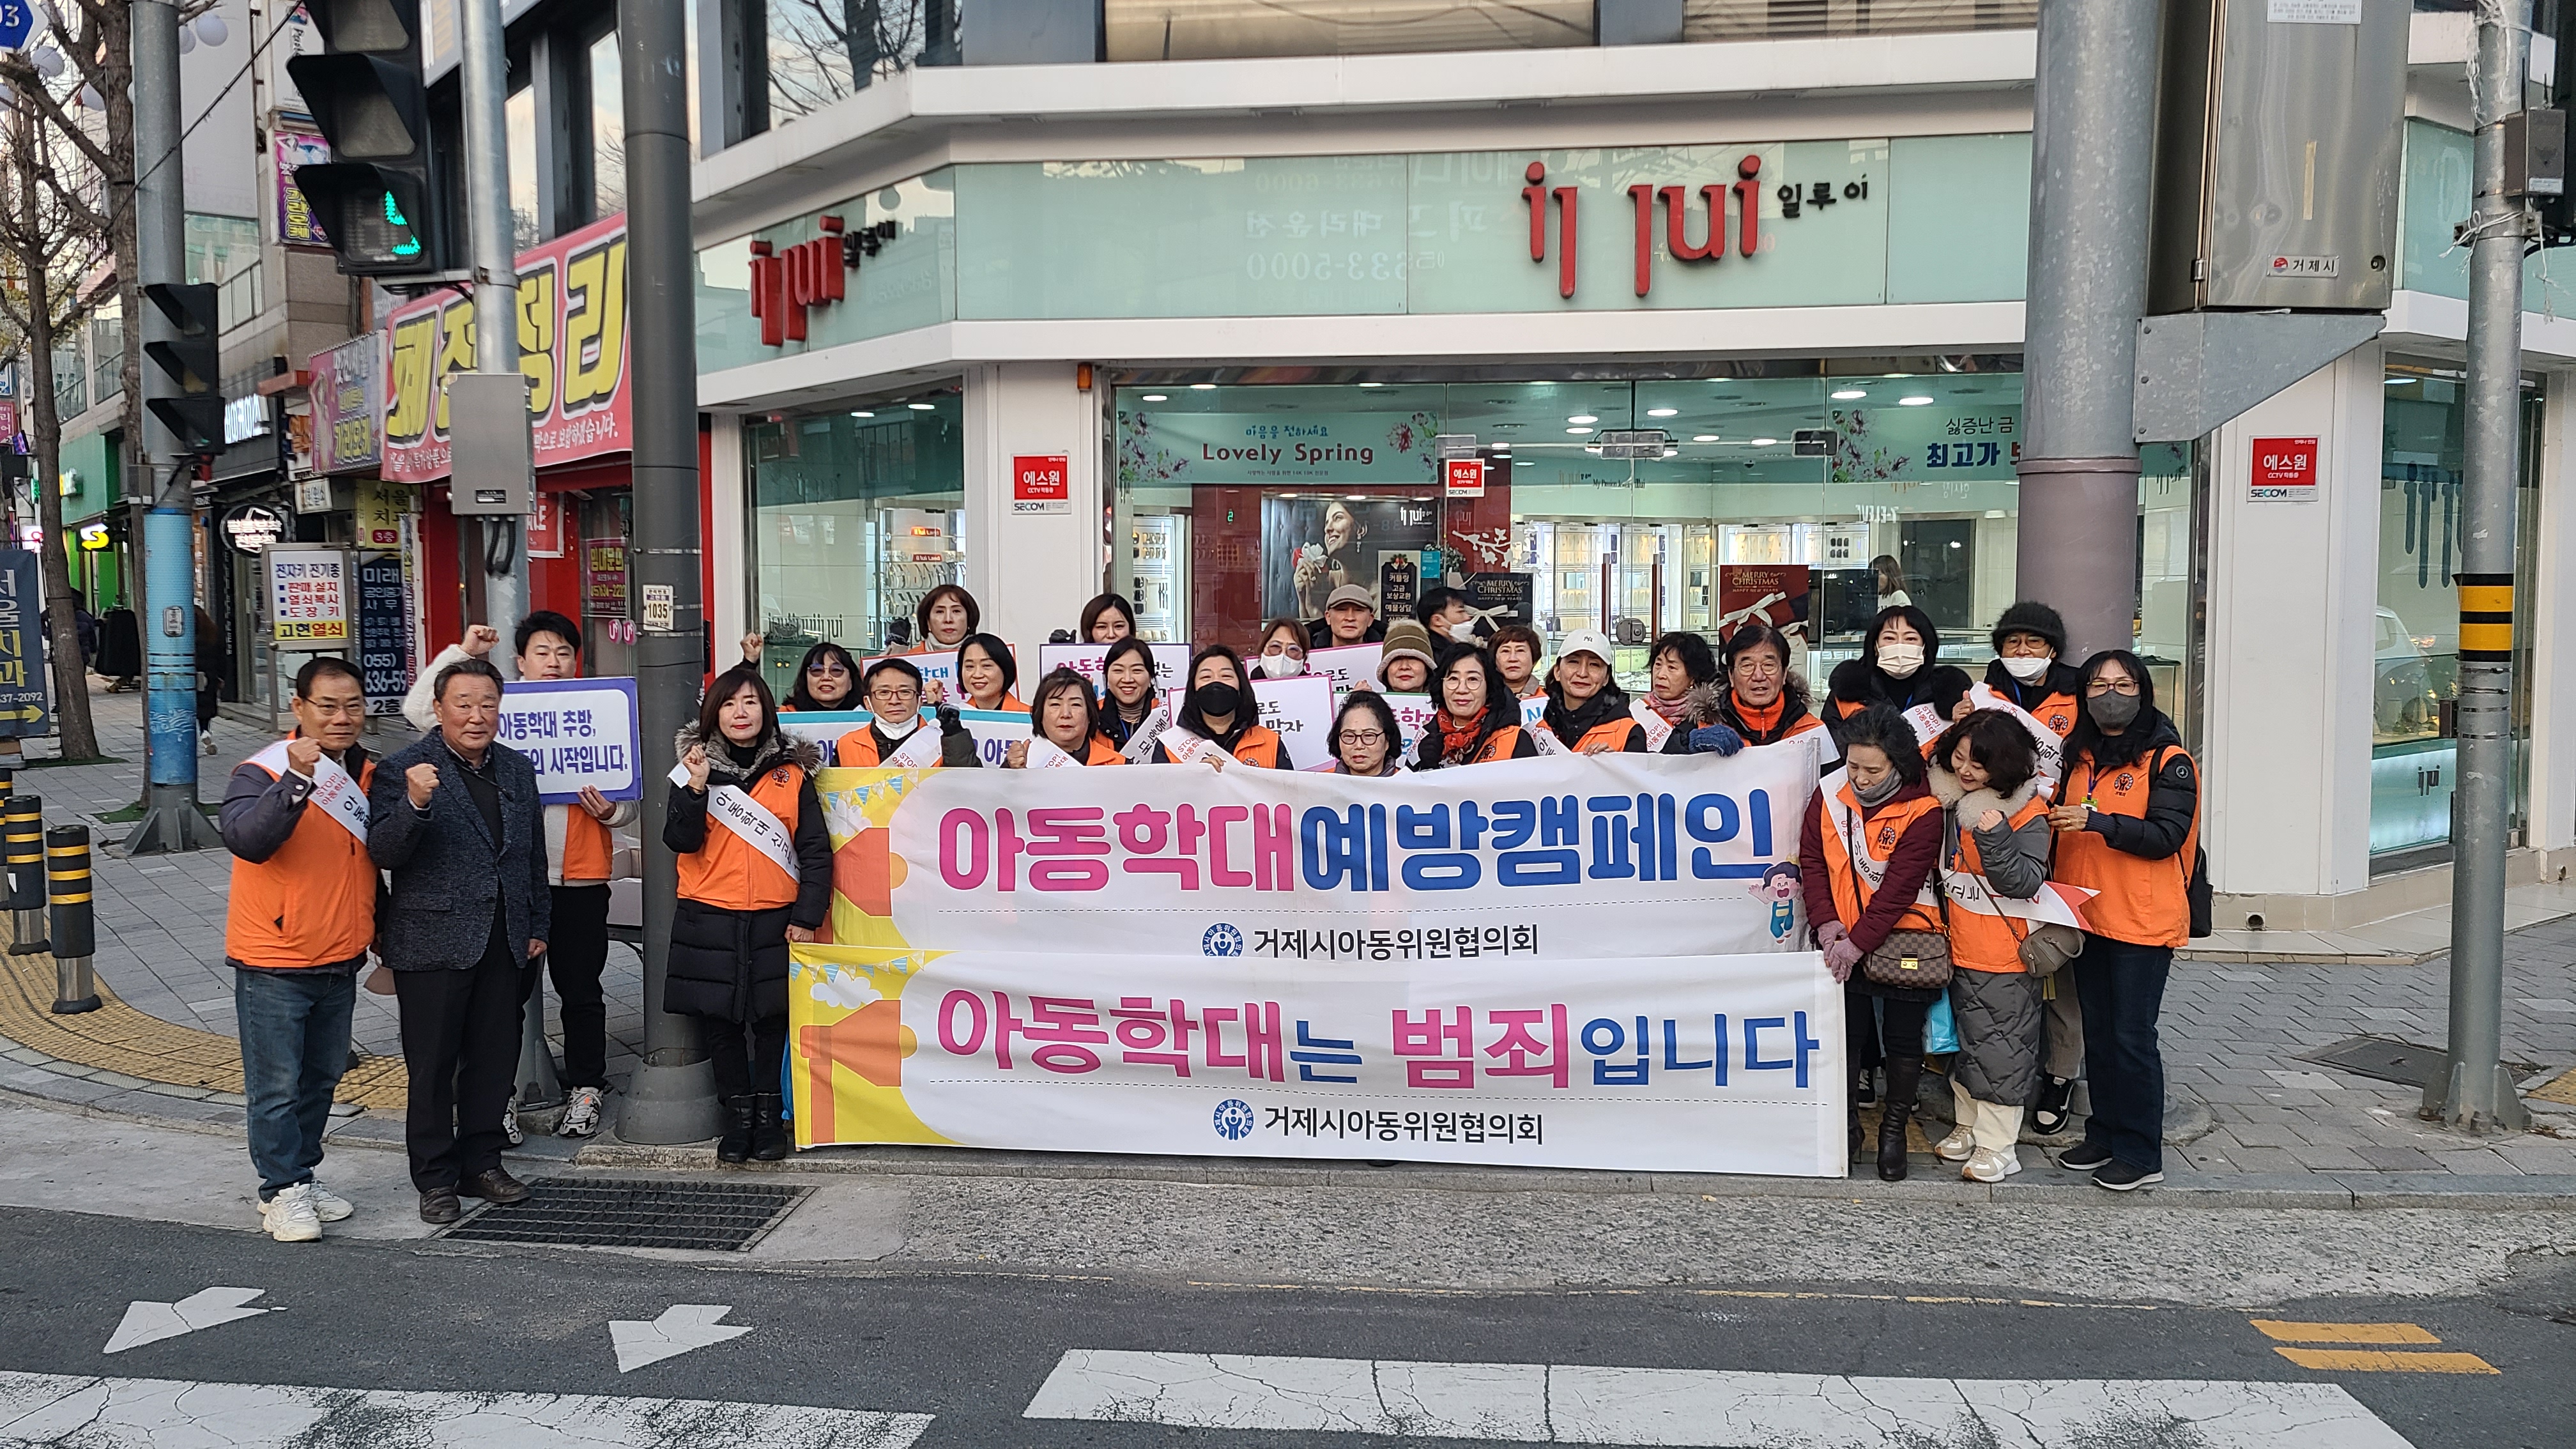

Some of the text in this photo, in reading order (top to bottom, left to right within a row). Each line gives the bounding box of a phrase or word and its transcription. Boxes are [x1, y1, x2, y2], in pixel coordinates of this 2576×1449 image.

[1777, 174, 1869, 218] 일루이
[2292, 259, 2335, 273] 거제시
[1284, 424, 1329, 438] 전하세요
[1946, 417, 2014, 435] 싫증난 금
[1202, 443, 1374, 465] Lovely Spring
[1926, 442, 2001, 468] 최고가
[2263, 454, 2308, 471] 에스원
[1022, 470, 1061, 486] 에스원
[1453, 468, 1478, 479] 에스원
[2250, 489, 2287, 498] SECOM
[1014, 502, 1045, 511] SECOM
[374, 530, 396, 542] 3층
[590, 546, 624, 572] 임대문의
[363, 568, 400, 583] 미래
[1731, 576, 1780, 586] CHRISTMAS
[1741, 571, 1769, 579] MERRY
[1476, 586, 1522, 594] CHRISTMAS
[1487, 579, 1513, 588] MERRY
[648, 603, 668, 619] 1035
[279, 622, 343, 637] 고현열쇠
[363, 652, 397, 668] 055)
[372, 699, 400, 714] 2층
[498, 709, 596, 740] 아동학대 추방,
[1922, 706, 1941, 728] STOP!
[549, 744, 628, 774] 시작입니다.
[316, 772, 339, 797] STOP!
[321, 775, 349, 806] 아동학대
[939, 788, 1774, 893] 아동학대예방캠페인
[1254, 924, 1538, 960] 거제시아동위원협의회
[938, 989, 1820, 1089] 아동학대는 범죄입니다
[1264, 1106, 1544, 1146] 거제시아동위원협의회
